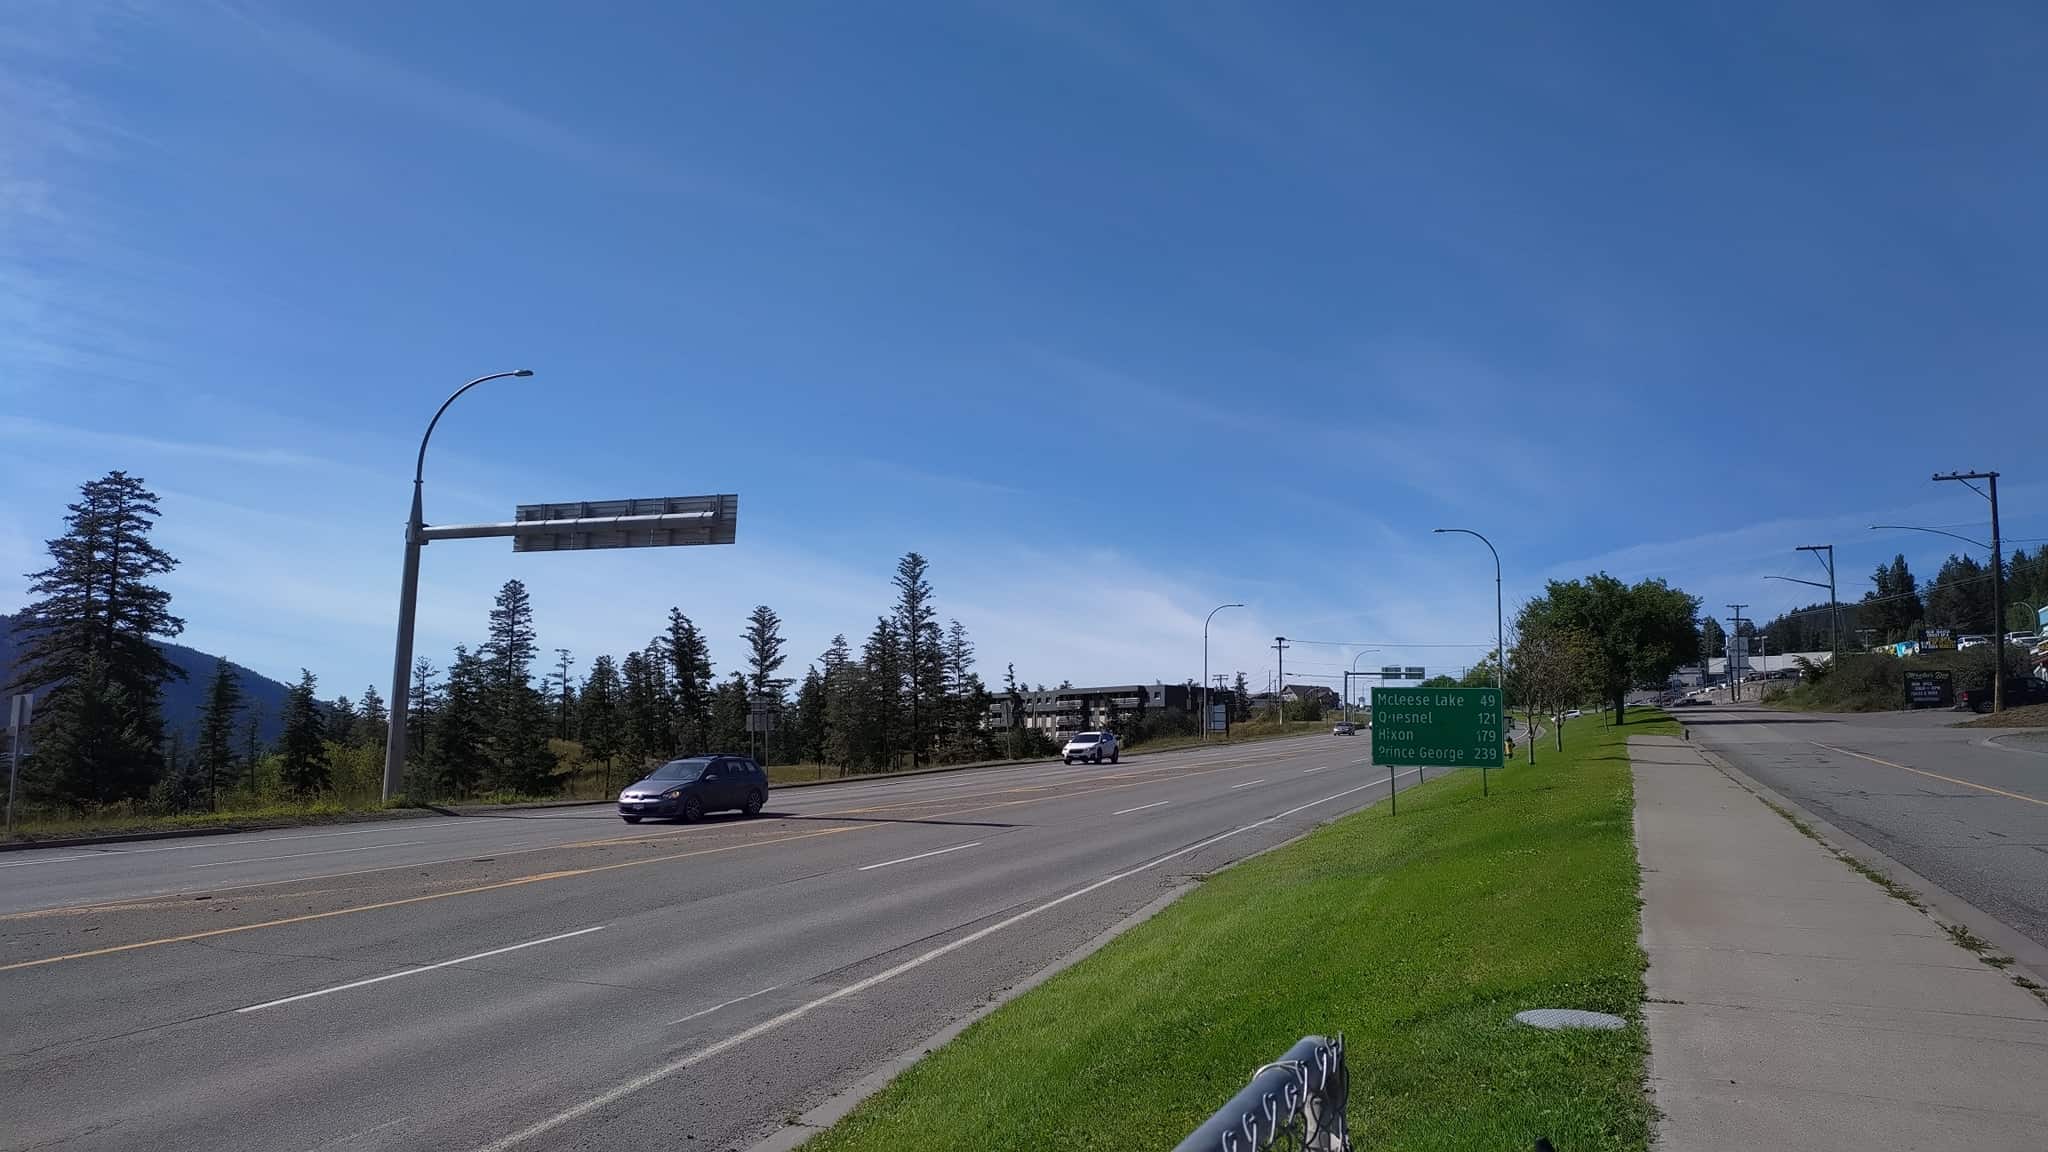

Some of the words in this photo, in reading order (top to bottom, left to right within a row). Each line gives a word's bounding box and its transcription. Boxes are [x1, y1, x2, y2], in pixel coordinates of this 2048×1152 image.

[1435, 694, 1464, 707] Lake
[1480, 695, 1496, 707] 49
[1478, 712, 1496, 725] 121
[1378, 728, 1414, 741] Hixon
[1477, 730, 1497, 743] 179
[1419, 747, 1464, 762] George
[1474, 747, 1497, 760] 239
